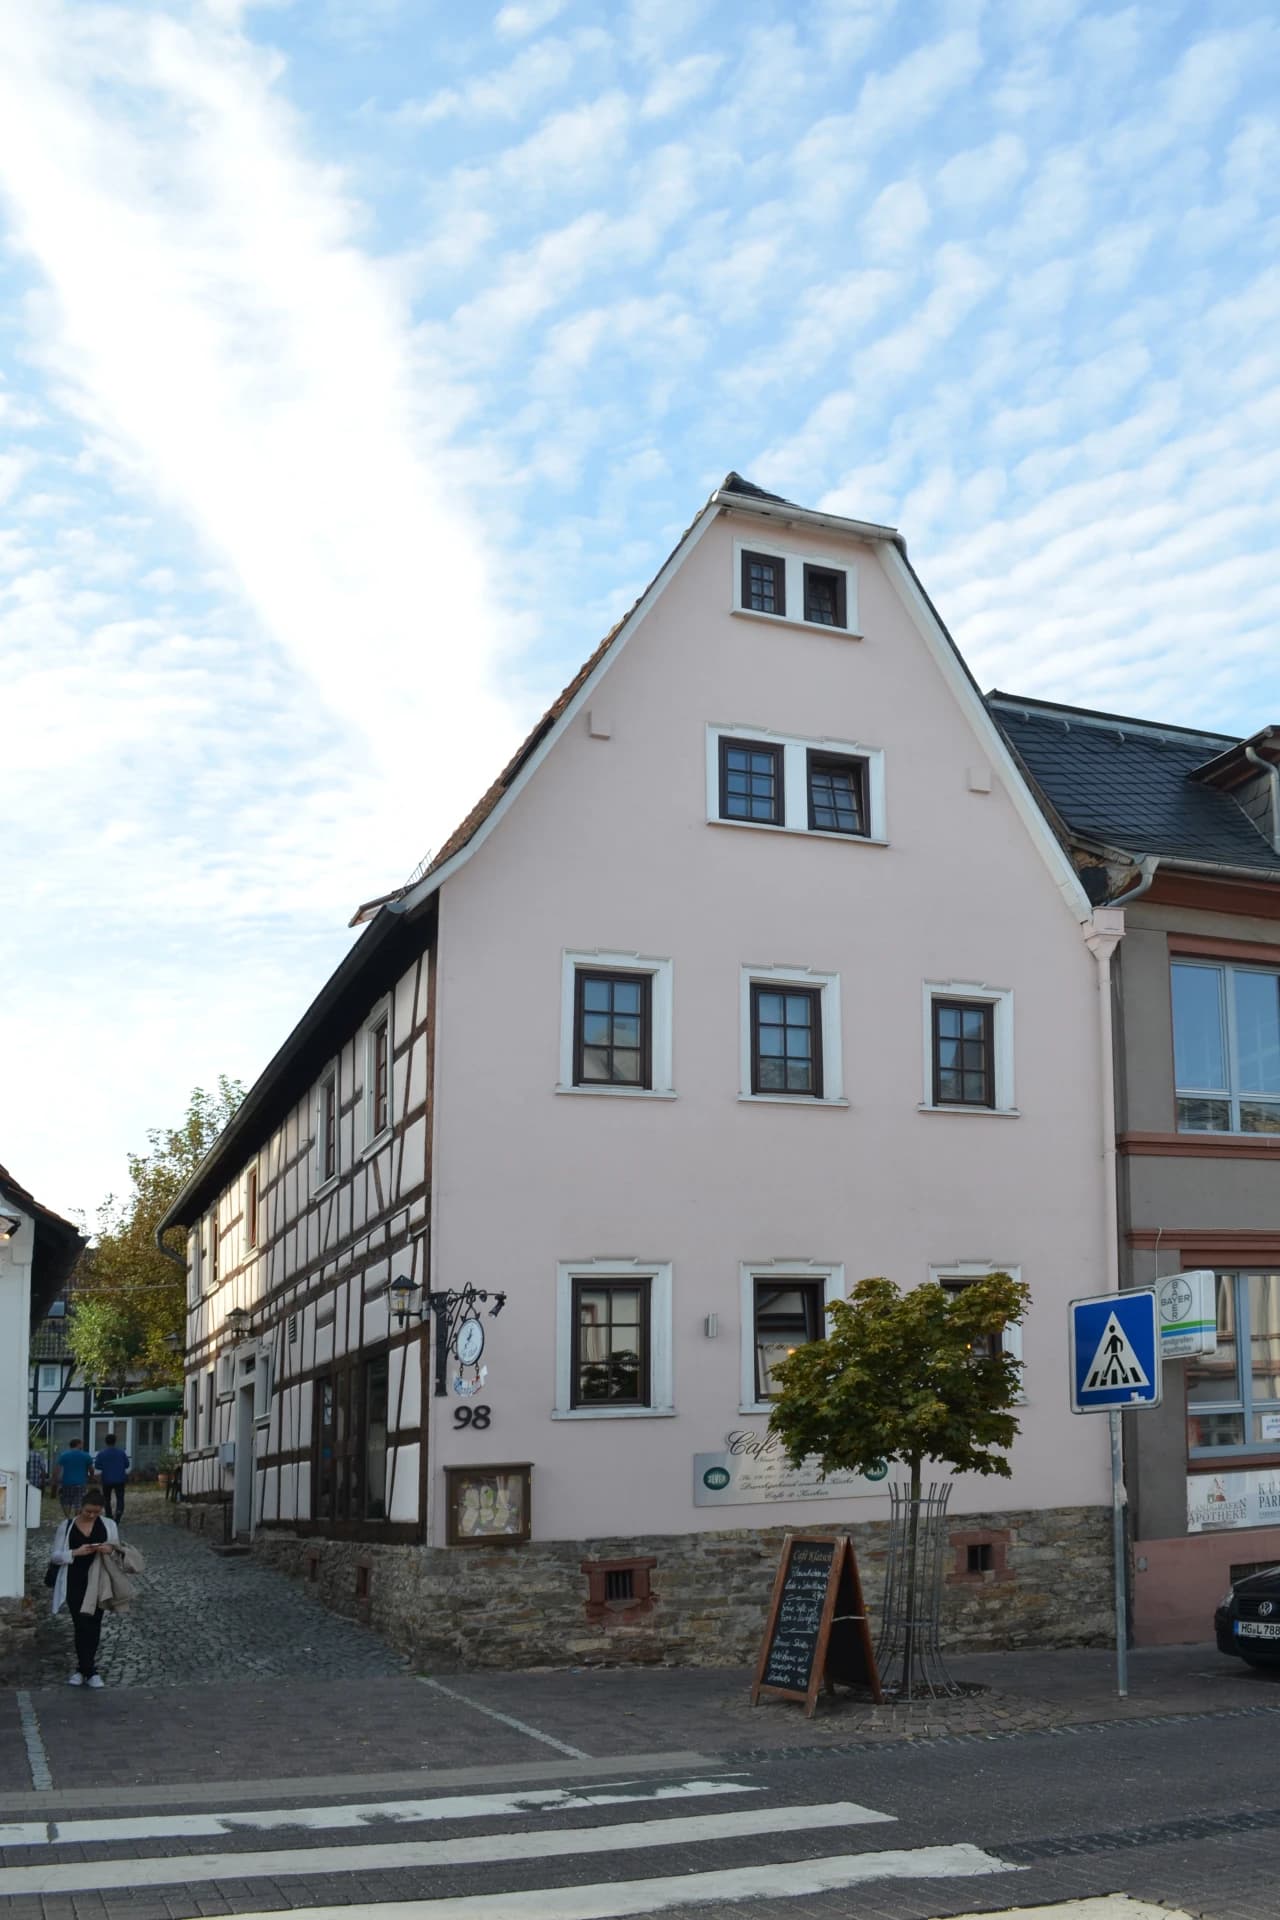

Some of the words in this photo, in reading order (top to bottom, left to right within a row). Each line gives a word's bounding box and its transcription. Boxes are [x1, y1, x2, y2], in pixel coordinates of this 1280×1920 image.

[1161, 1294, 1190, 1306] BAYER
[453, 1404, 491, 1430] 98
[728, 1430, 780, 1460] Café
[1258, 1481, 1280, 1495] KU
[1259, 1494, 1280, 1509] PAR
